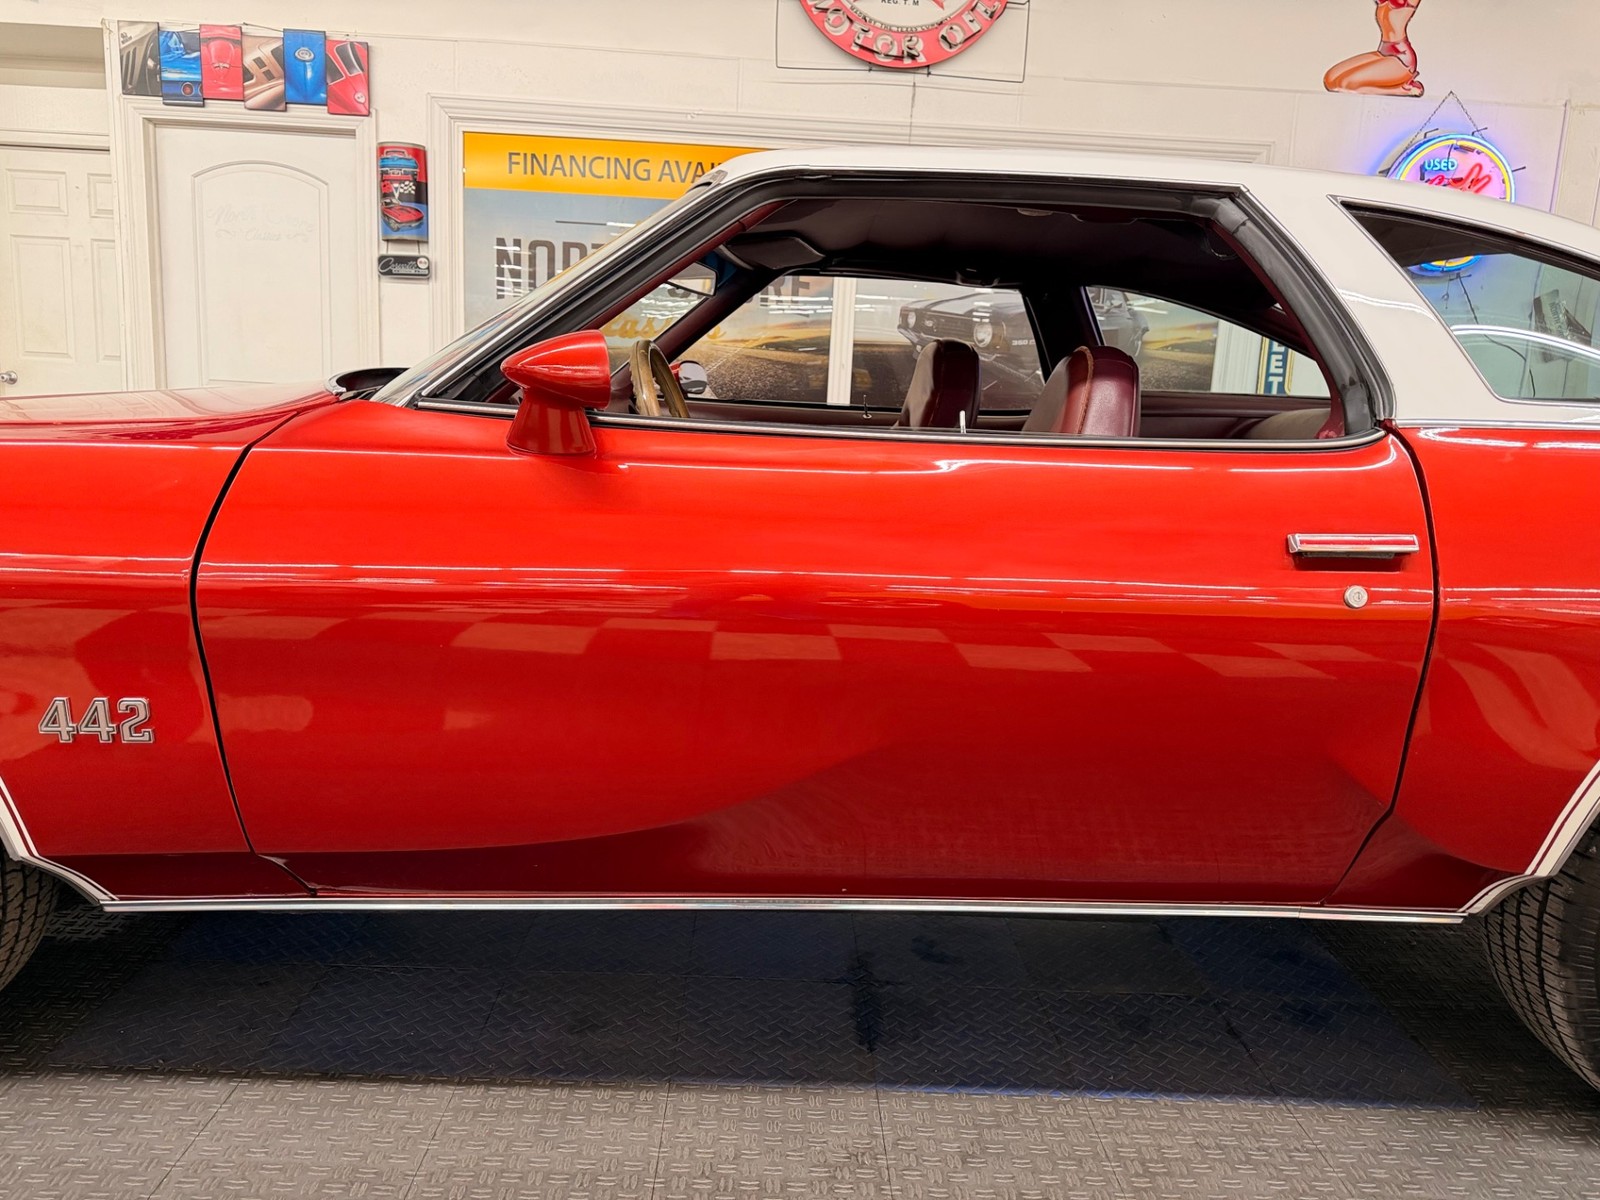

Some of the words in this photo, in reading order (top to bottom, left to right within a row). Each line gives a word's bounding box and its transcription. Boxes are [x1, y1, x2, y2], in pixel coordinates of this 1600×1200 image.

[507, 151, 651, 182] FINANCING
[1424, 157, 1459, 171] USED
[39, 697, 154, 743] 442
